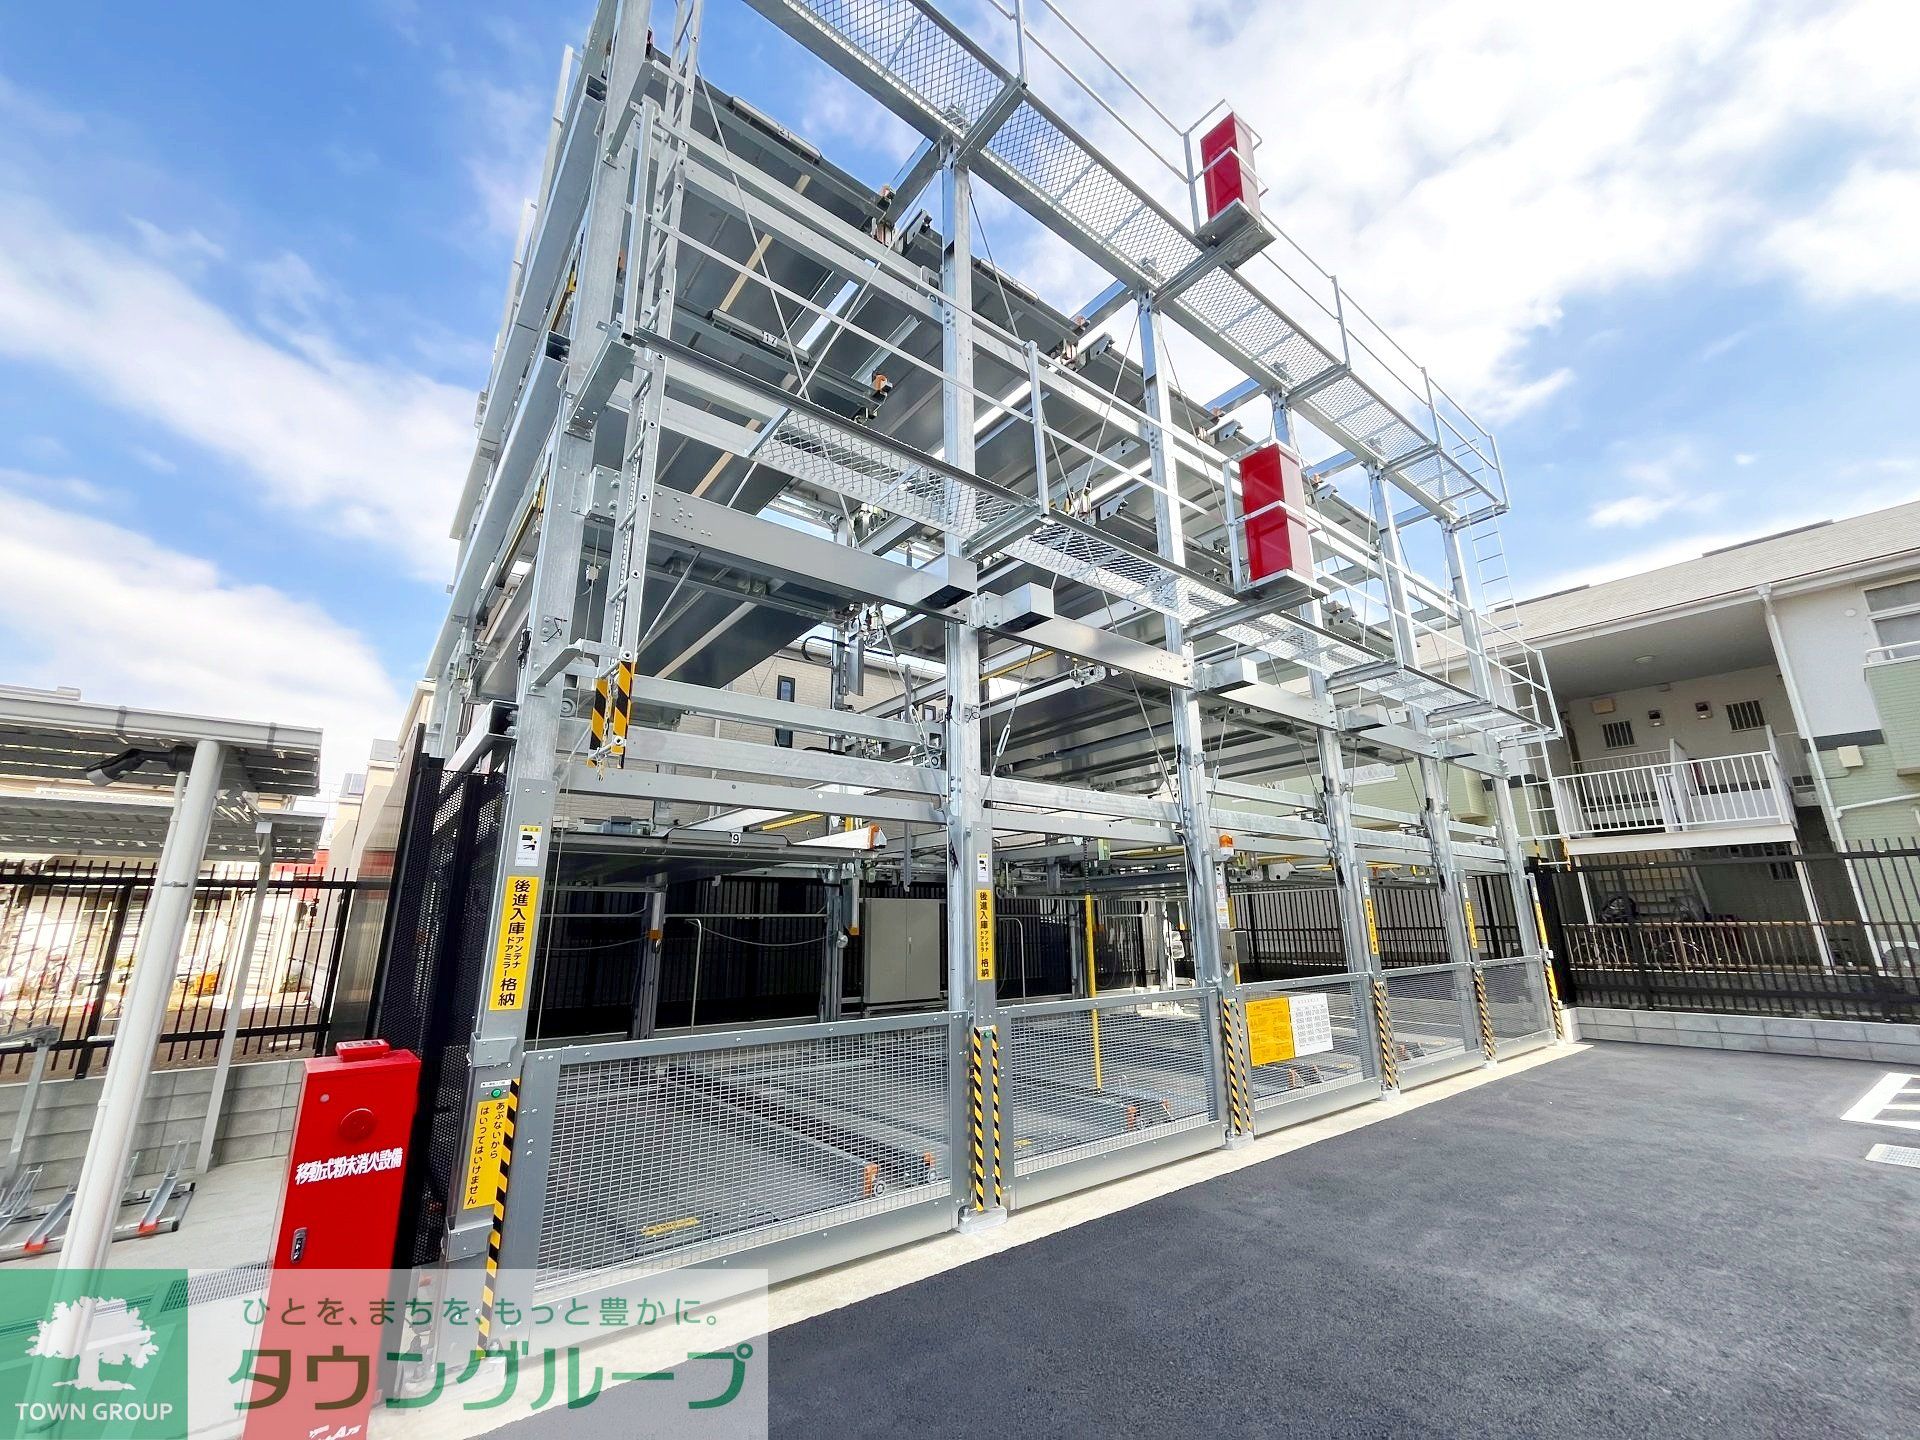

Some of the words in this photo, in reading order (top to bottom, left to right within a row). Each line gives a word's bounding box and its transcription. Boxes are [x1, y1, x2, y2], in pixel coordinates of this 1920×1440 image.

[508, 879, 530, 935] 後進入庫
[979, 891, 988, 929] 後進入庫
[502, 936, 514, 976] ドアミラー
[512, 936, 524, 969] アンテナ
[497, 977, 517, 1007] 格納
[490, 1102, 505, 1159] あぶないから
[295, 1147, 403, 1185] 移動式粉末消火設備
[467, 1106, 490, 1205] はいってはいけません
